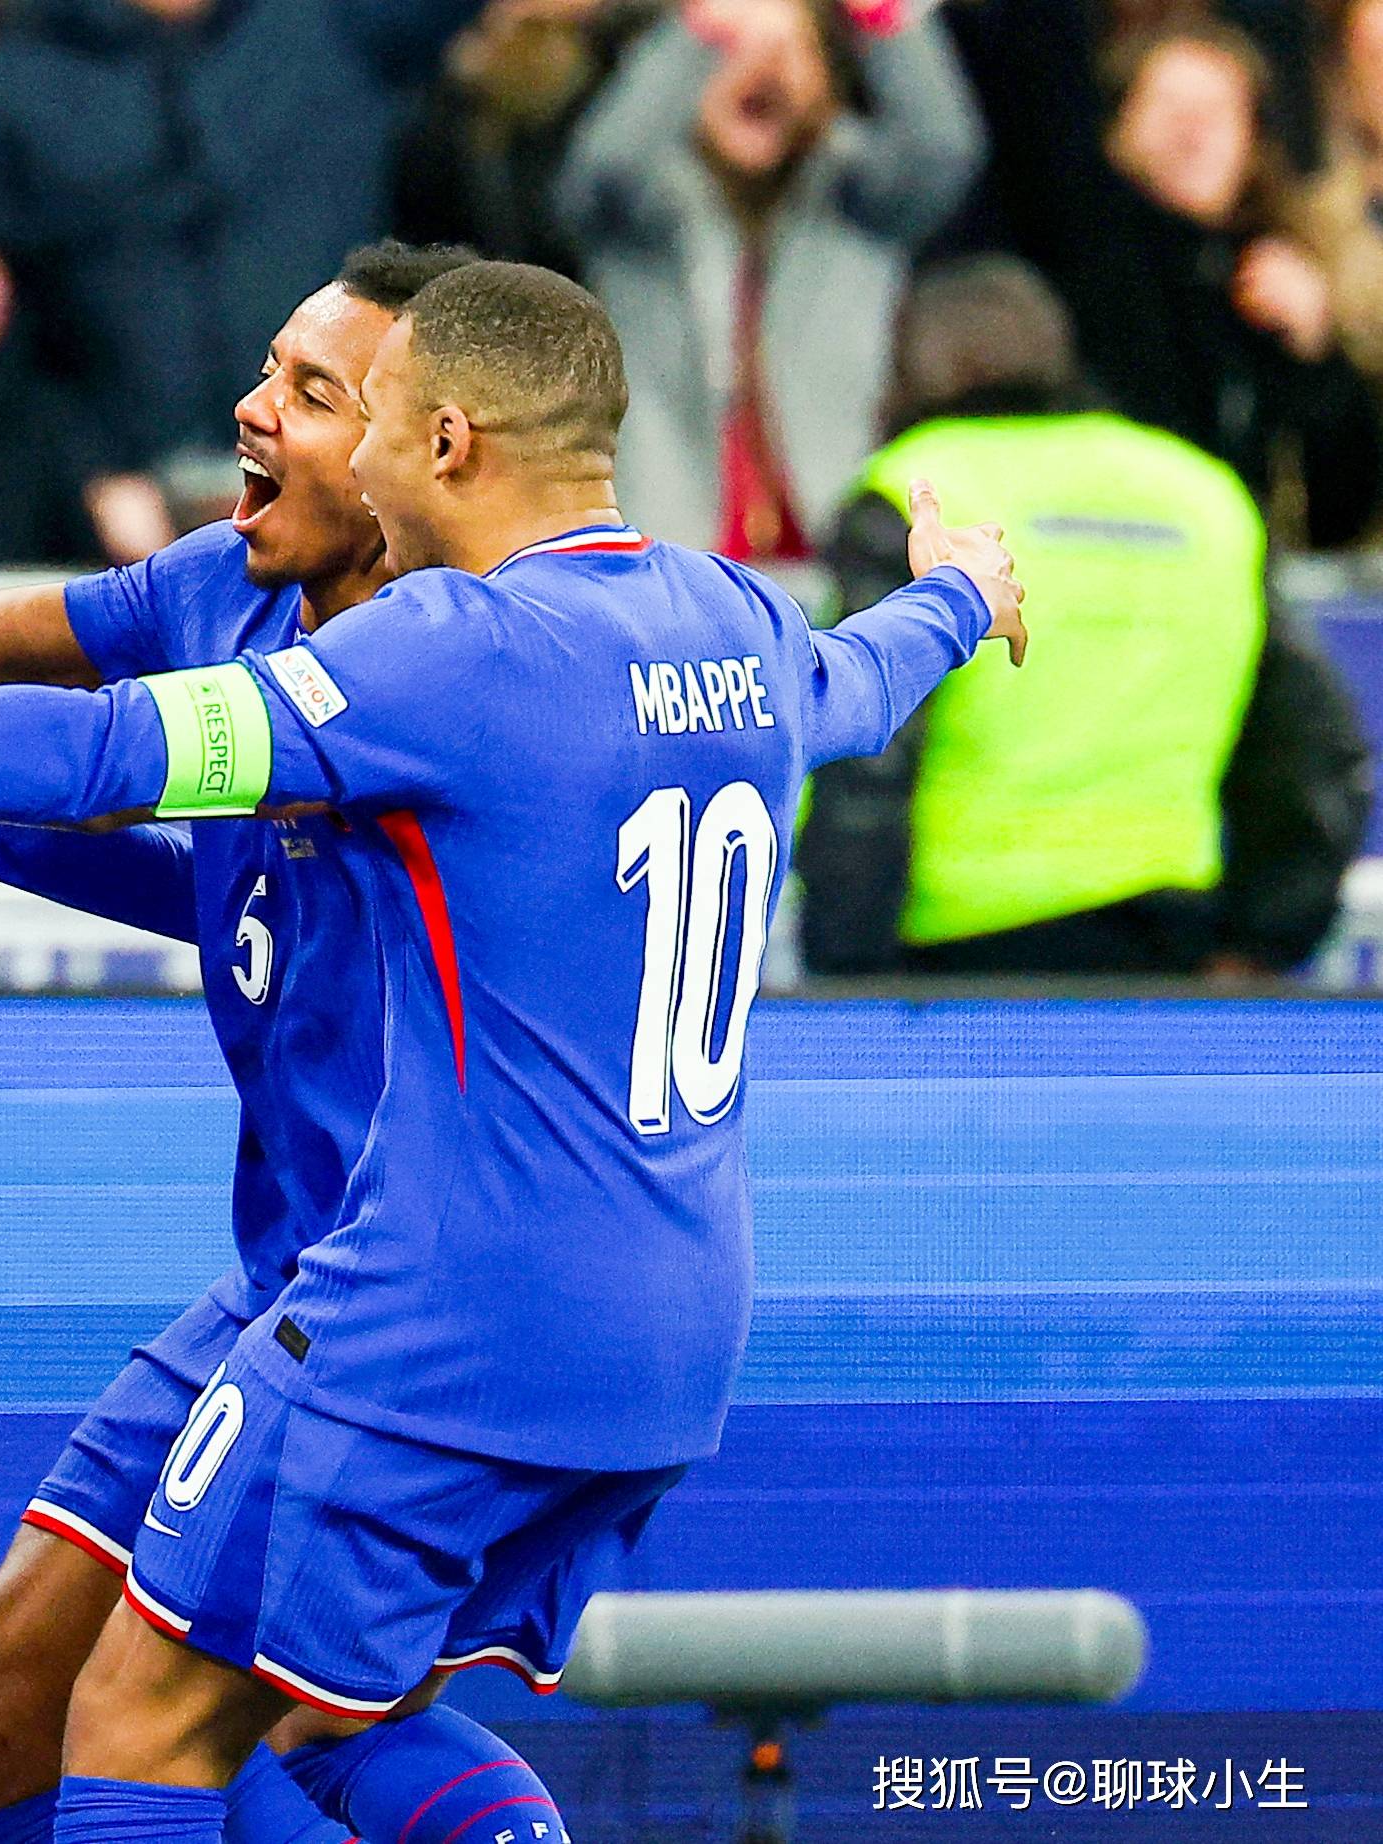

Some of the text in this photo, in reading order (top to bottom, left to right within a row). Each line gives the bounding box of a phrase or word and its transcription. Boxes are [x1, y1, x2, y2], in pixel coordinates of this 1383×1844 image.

[203, 703, 228, 794] RESPECT
[629, 656, 775, 735] MBAPPE
[232, 875, 273, 1005] 5
[616, 780, 777, 1134] 10
